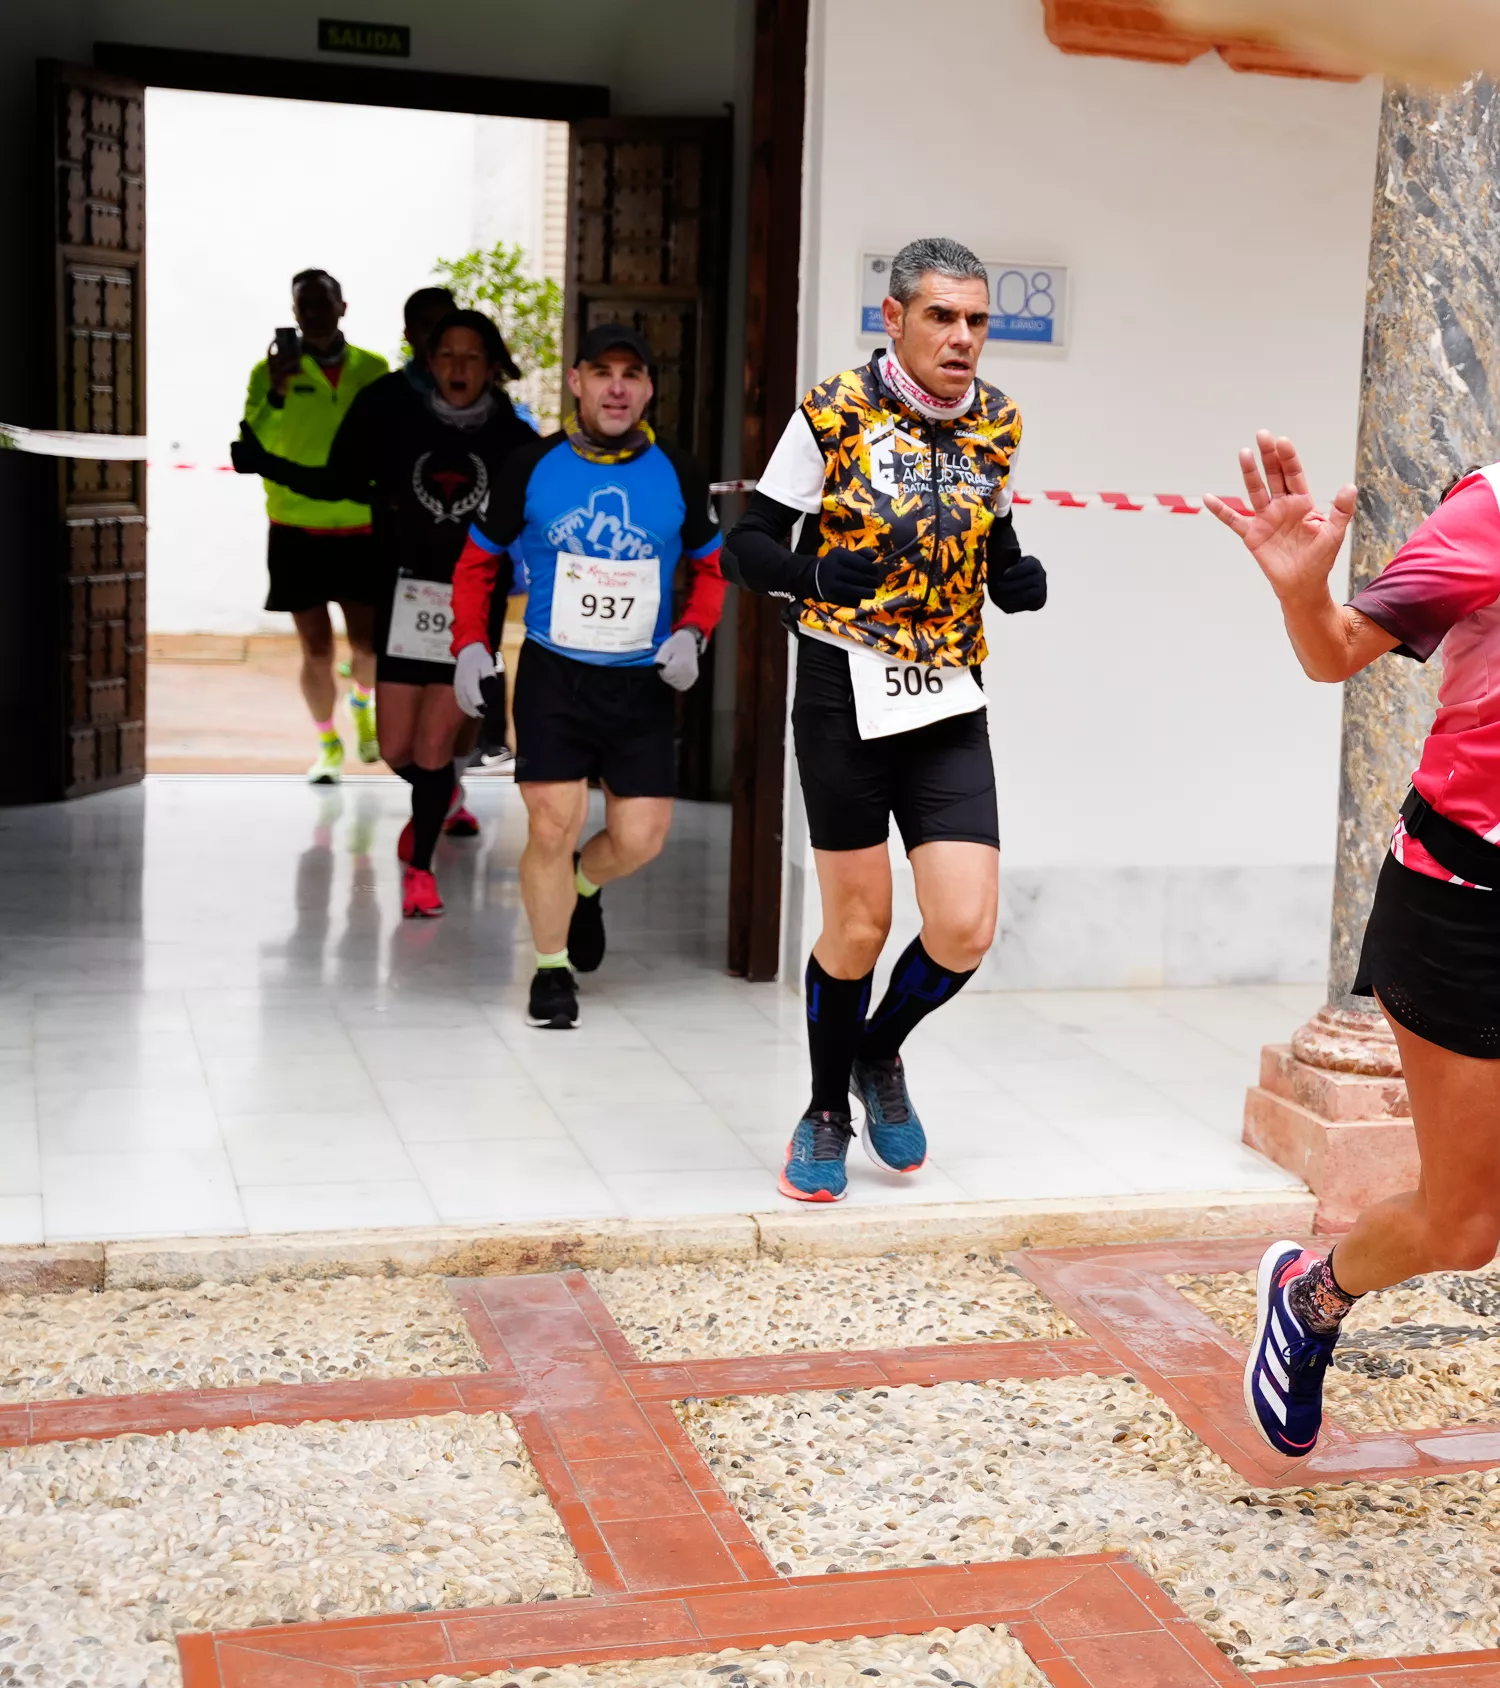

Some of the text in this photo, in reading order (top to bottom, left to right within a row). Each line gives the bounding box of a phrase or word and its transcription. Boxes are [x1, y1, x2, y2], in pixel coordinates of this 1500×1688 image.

[327, 26, 402, 51] SALIDA
[997, 270, 1055, 318] 08
[901, 451, 971, 469] CASTILLO
[903, 482, 945, 495] BATALA
[946, 485, 958, 495] DE
[955, 469, 995, 487] TRAIL
[581, 594, 635, 619] 937
[415, 610, 451, 634] 89
[885, 665, 943, 697] 506
